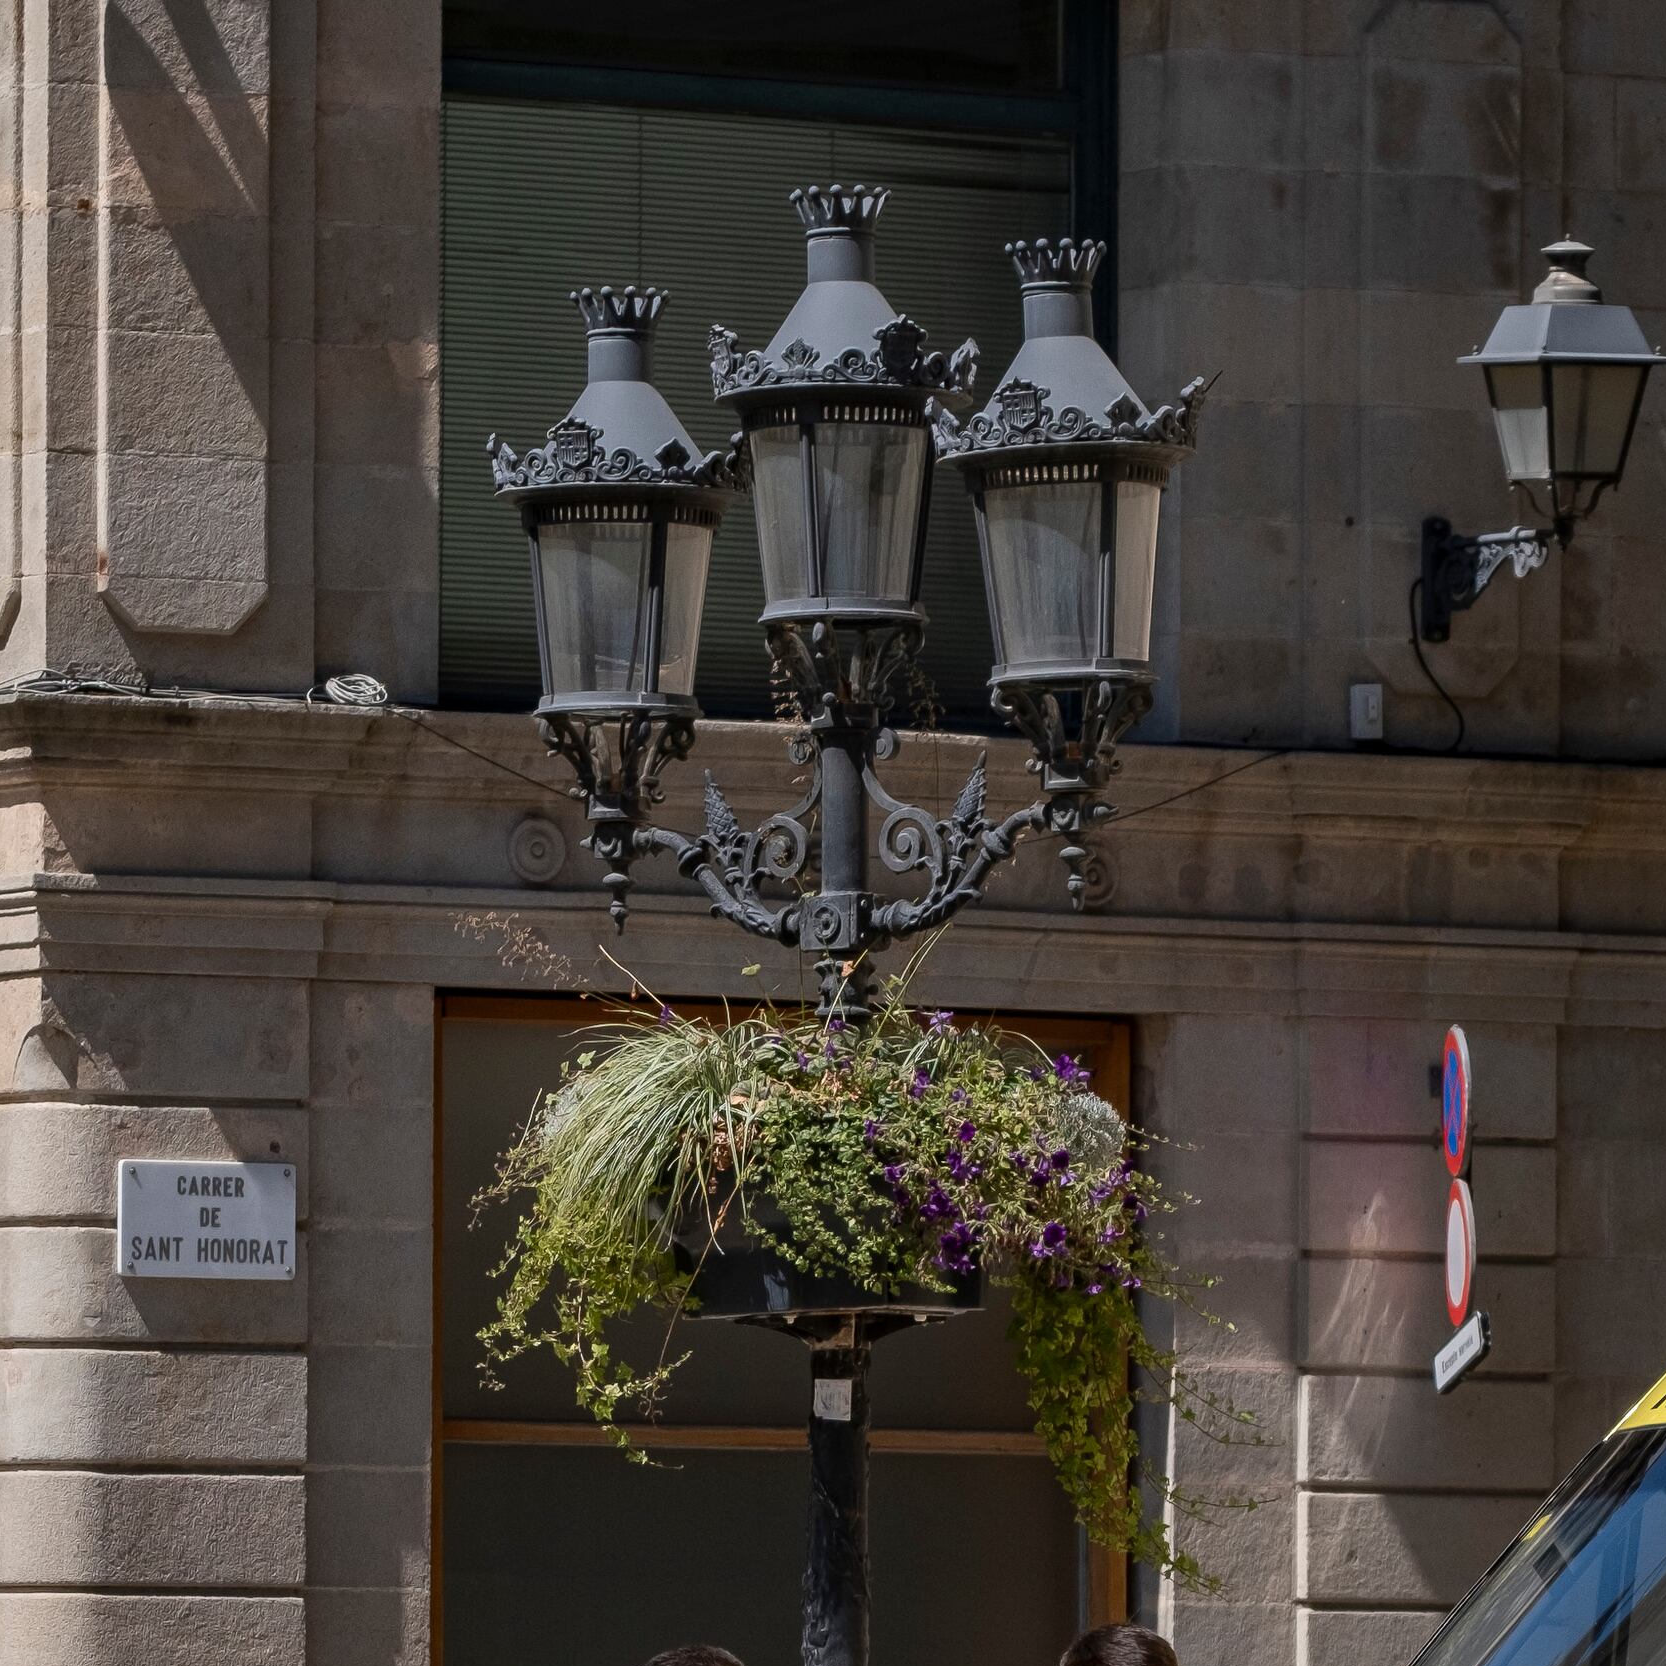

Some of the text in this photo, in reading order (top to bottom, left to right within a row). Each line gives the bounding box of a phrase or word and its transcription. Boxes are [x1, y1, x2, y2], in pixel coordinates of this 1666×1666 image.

[177, 1175, 245, 1198] CARRER
[200, 1206, 221, 1228] DE
[132, 1236, 288, 1265] SANT HONORAT
